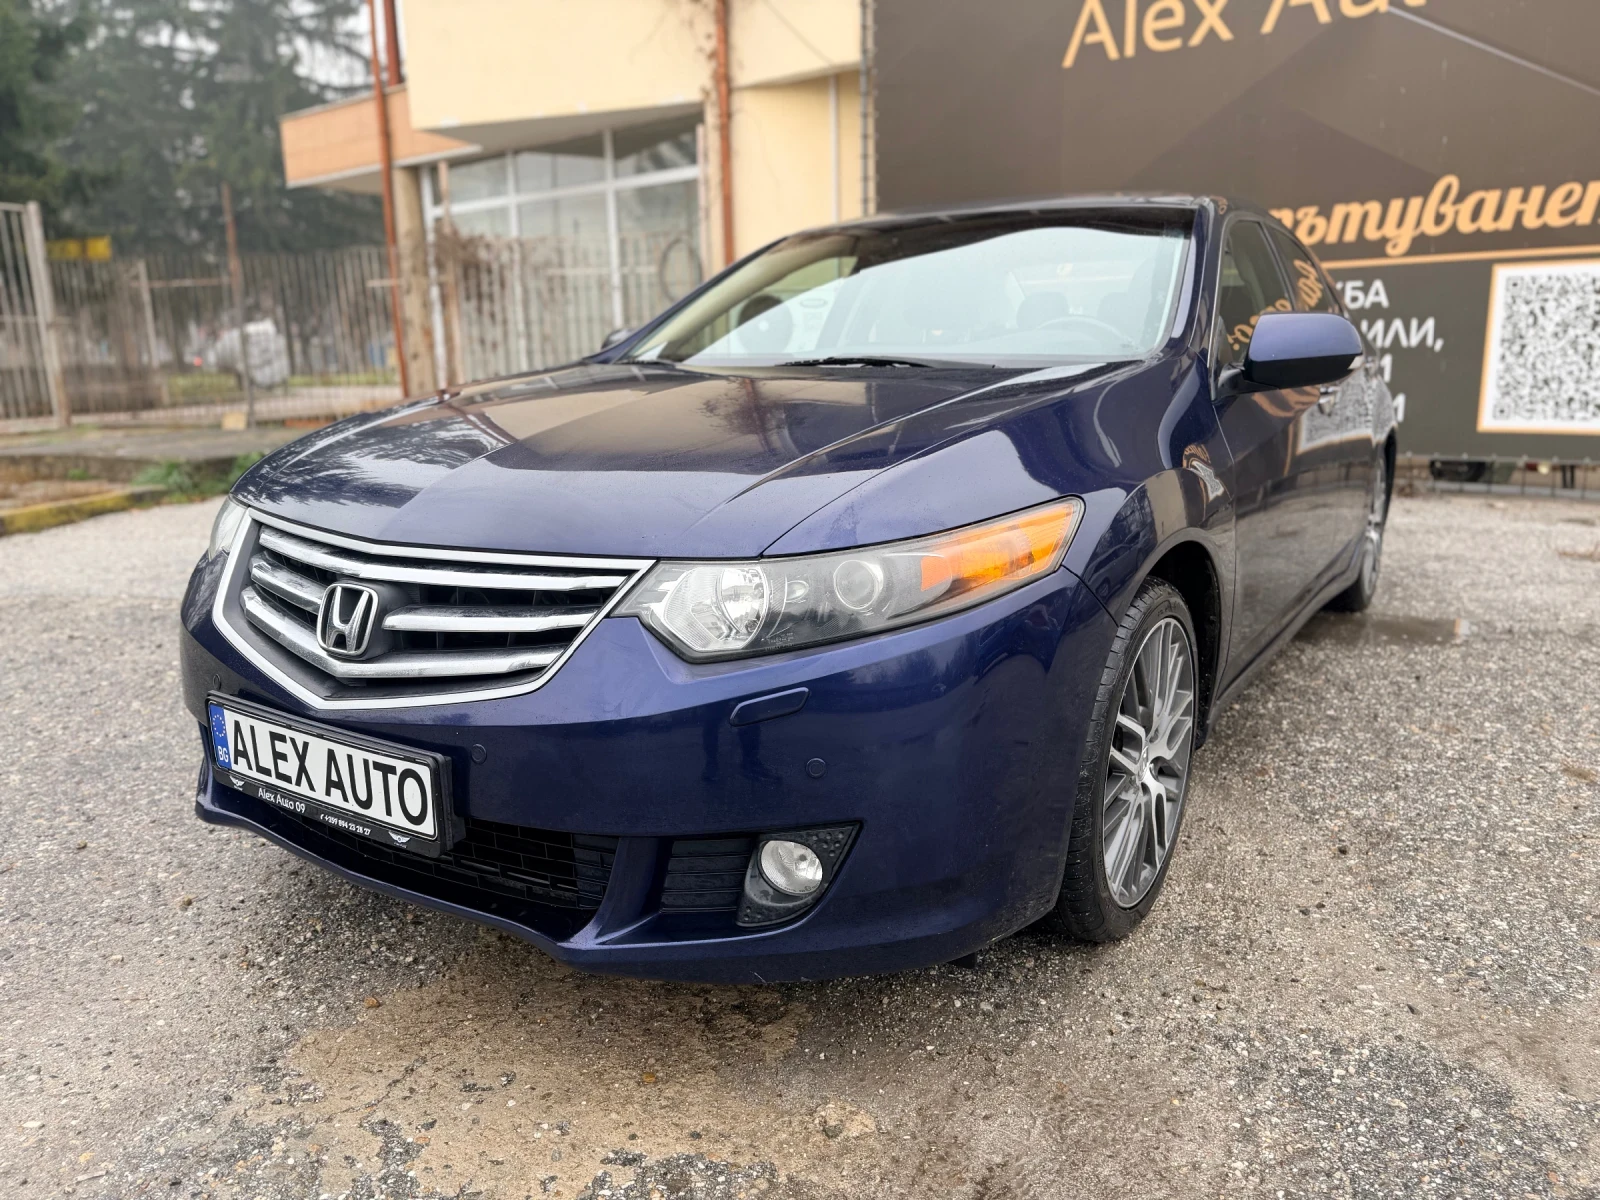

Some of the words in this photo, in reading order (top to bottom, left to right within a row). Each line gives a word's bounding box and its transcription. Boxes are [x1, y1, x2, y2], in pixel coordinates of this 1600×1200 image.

[1062, 0, 1235, 69] Alex
[1335, 279, 1390, 310] БА
[217, 745, 229, 763] BG
[233, 719, 316, 792] ALEX
[325, 748, 428, 826] AUTO
[258, 787, 275, 803] Alex
[276, 794, 295, 810] Auto
[295, 802, 306, 814] 09
